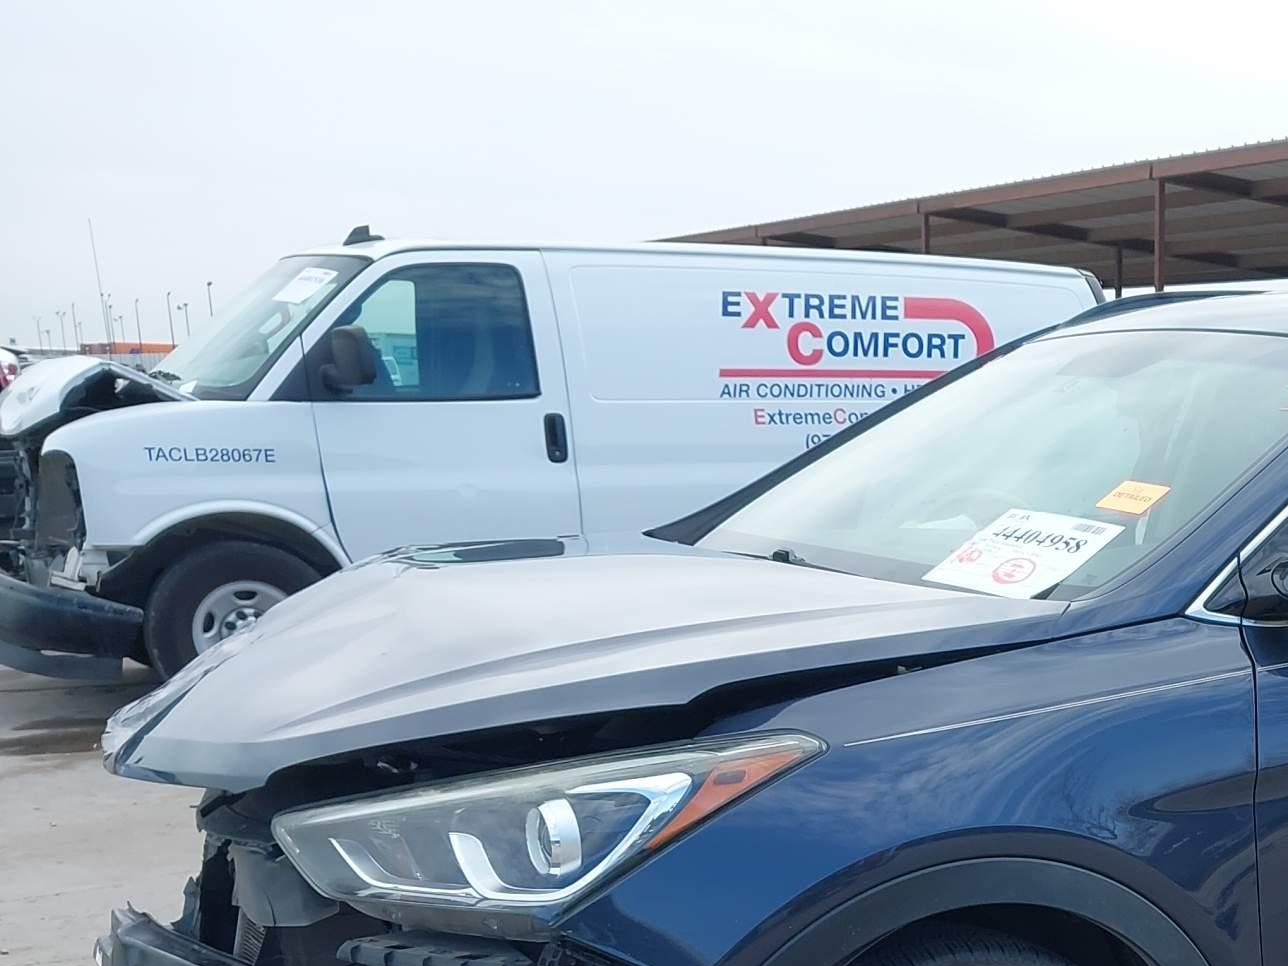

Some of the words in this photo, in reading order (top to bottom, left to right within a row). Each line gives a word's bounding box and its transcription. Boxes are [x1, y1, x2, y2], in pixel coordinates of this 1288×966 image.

[721, 290, 900, 329] EXTREME
[786, 321, 966, 366] COMFORT
[719, 383, 751, 398] AIR
[756, 383, 886, 398] CONDITIONING
[754, 408, 868, 425] ExtremeCo
[143, 447, 276, 462] TACLB28067E
[992, 526, 1088, 554] 44404958
